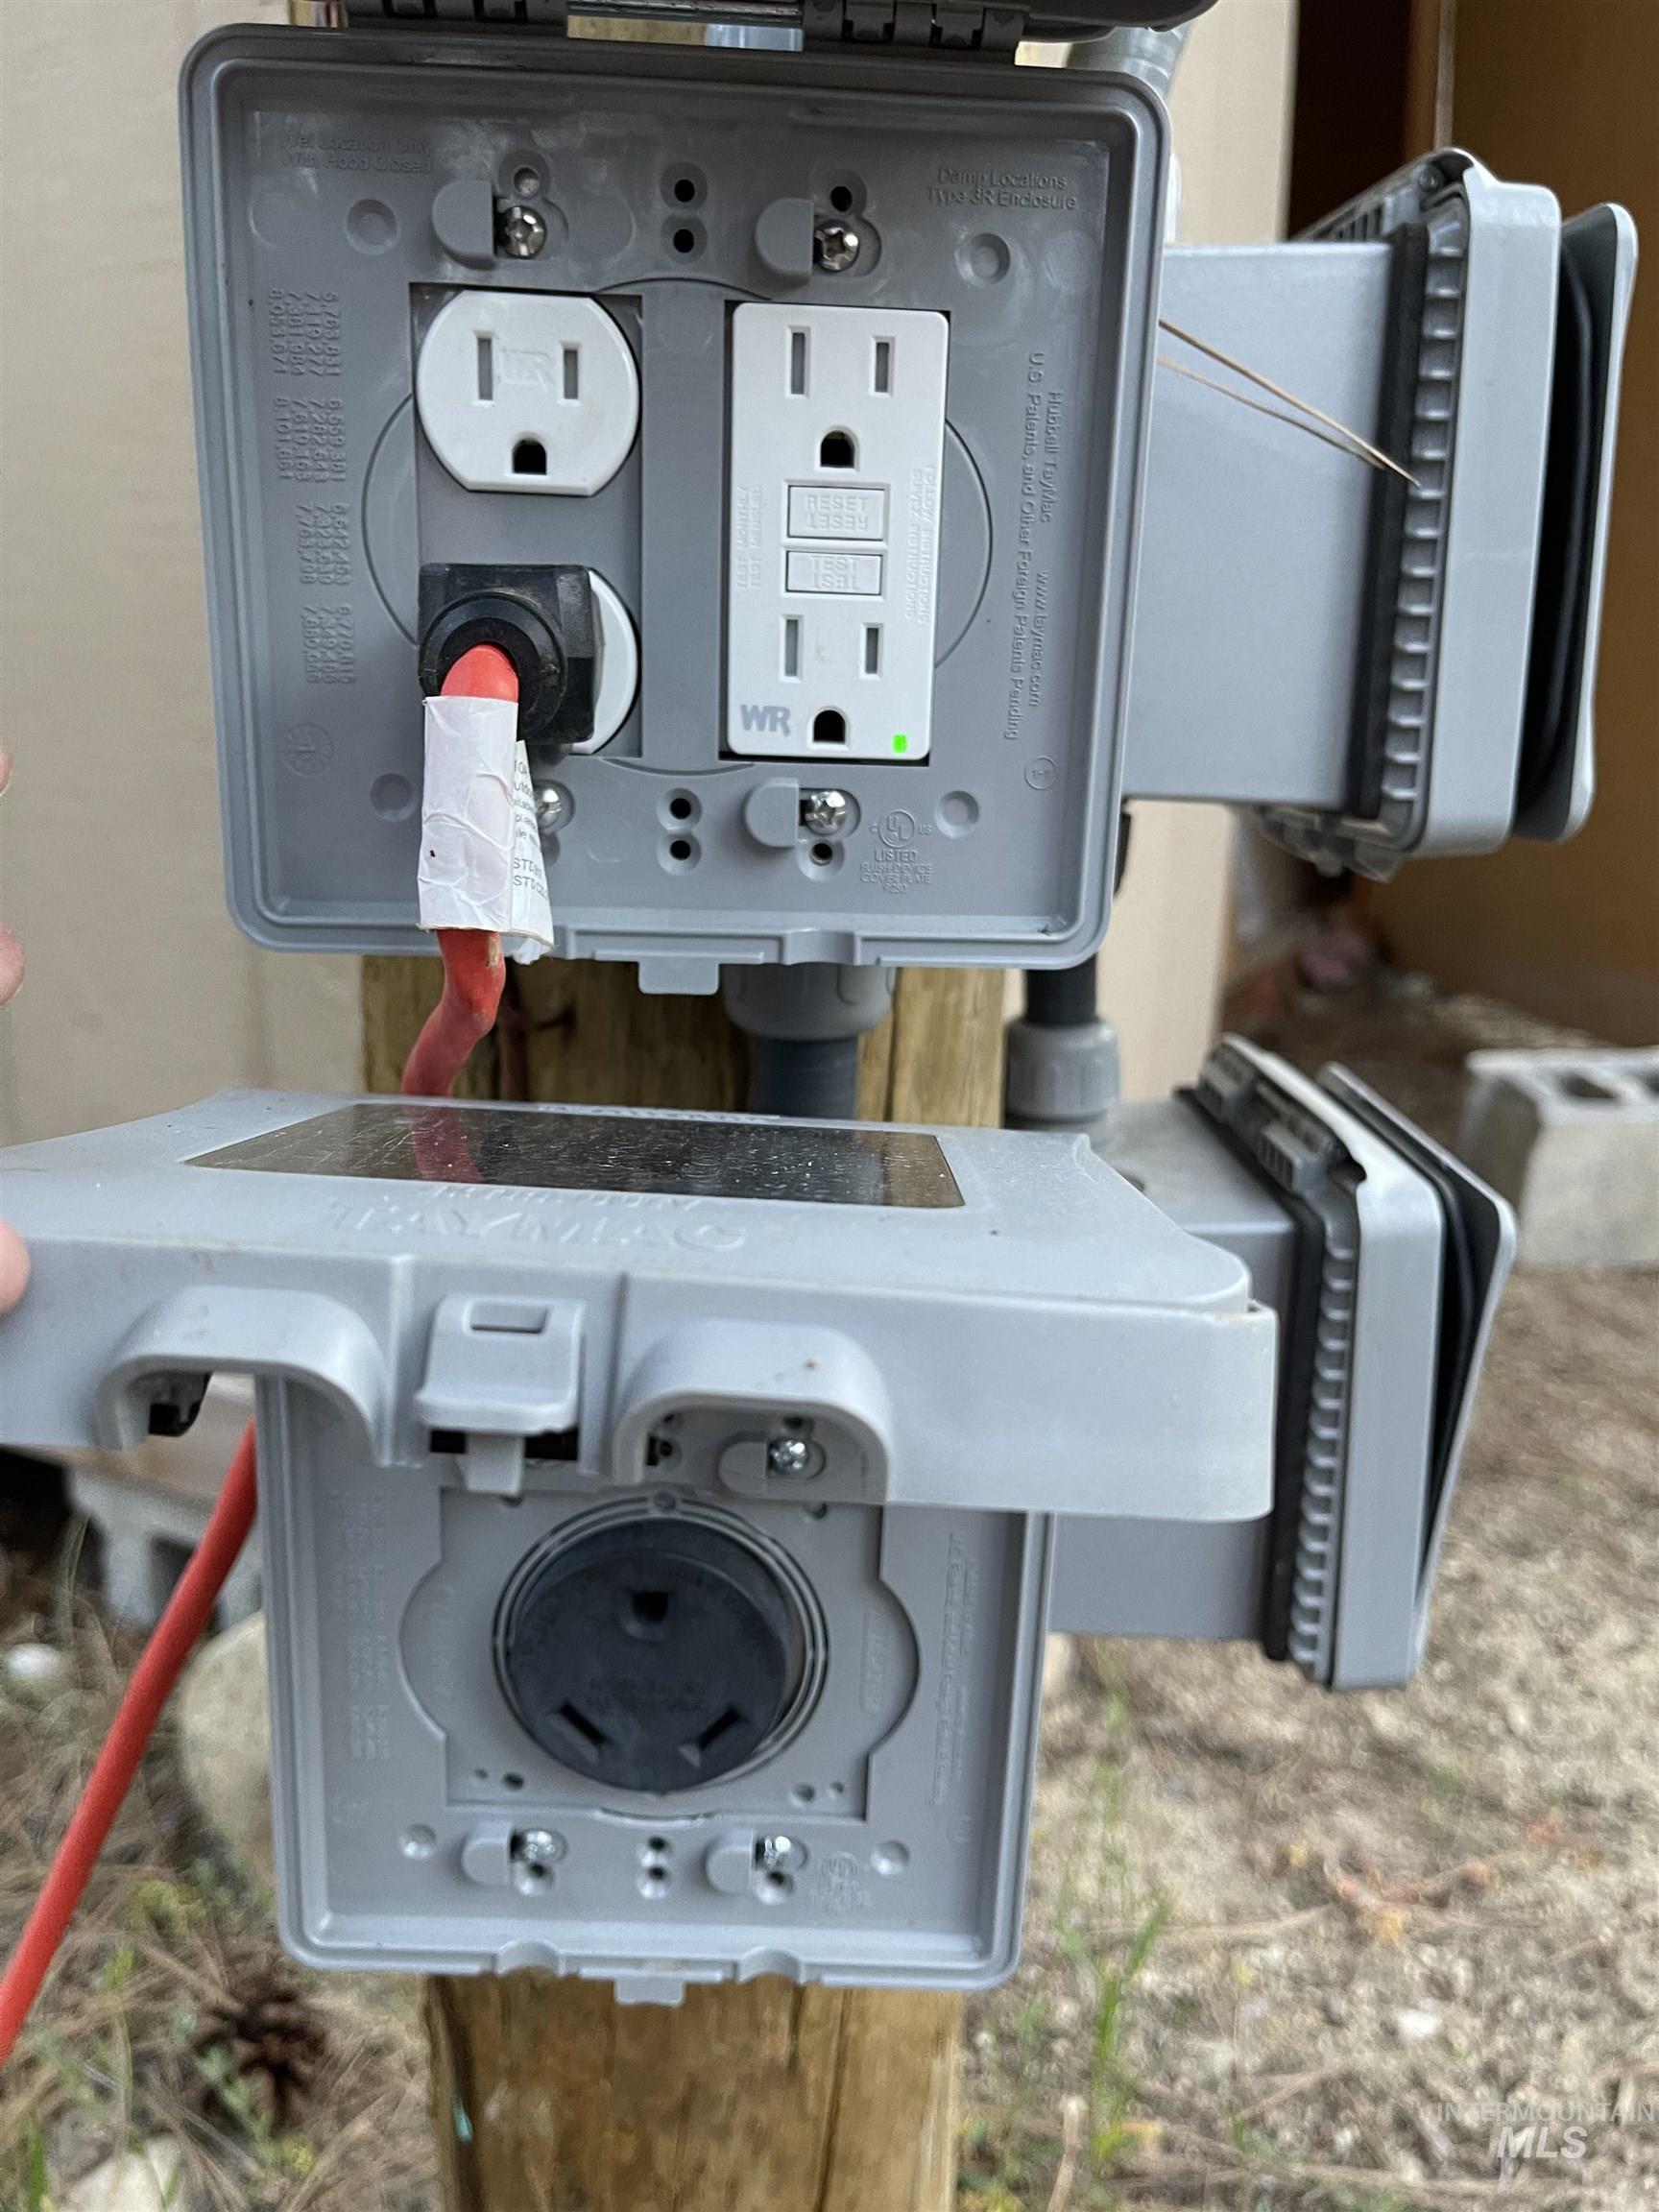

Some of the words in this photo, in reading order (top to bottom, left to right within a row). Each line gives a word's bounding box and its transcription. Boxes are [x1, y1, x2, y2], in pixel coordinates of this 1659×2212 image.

[937, 167, 986, 189] Damp
[990, 169, 1069, 191] Locations
[928, 186, 966, 207] Type
[998, 190, 1077, 211] Enclosure
[1045, 391, 1064, 454] Hubbell
[1021, 464, 1036, 496] and
[1039, 462, 1058, 523] TayMac
[806, 493, 870, 513] RESET
[806, 514, 870, 532] RESET
[1018, 500, 1035, 545] Other
[809, 555, 860, 573] TEST
[1013, 550, 1032, 611] Foreign
[1010, 614, 1028, 674] Patents
[739, 704, 793, 737] WR
[1004, 678, 1024, 740] Pending
[875, 848, 917, 863] LISTED
